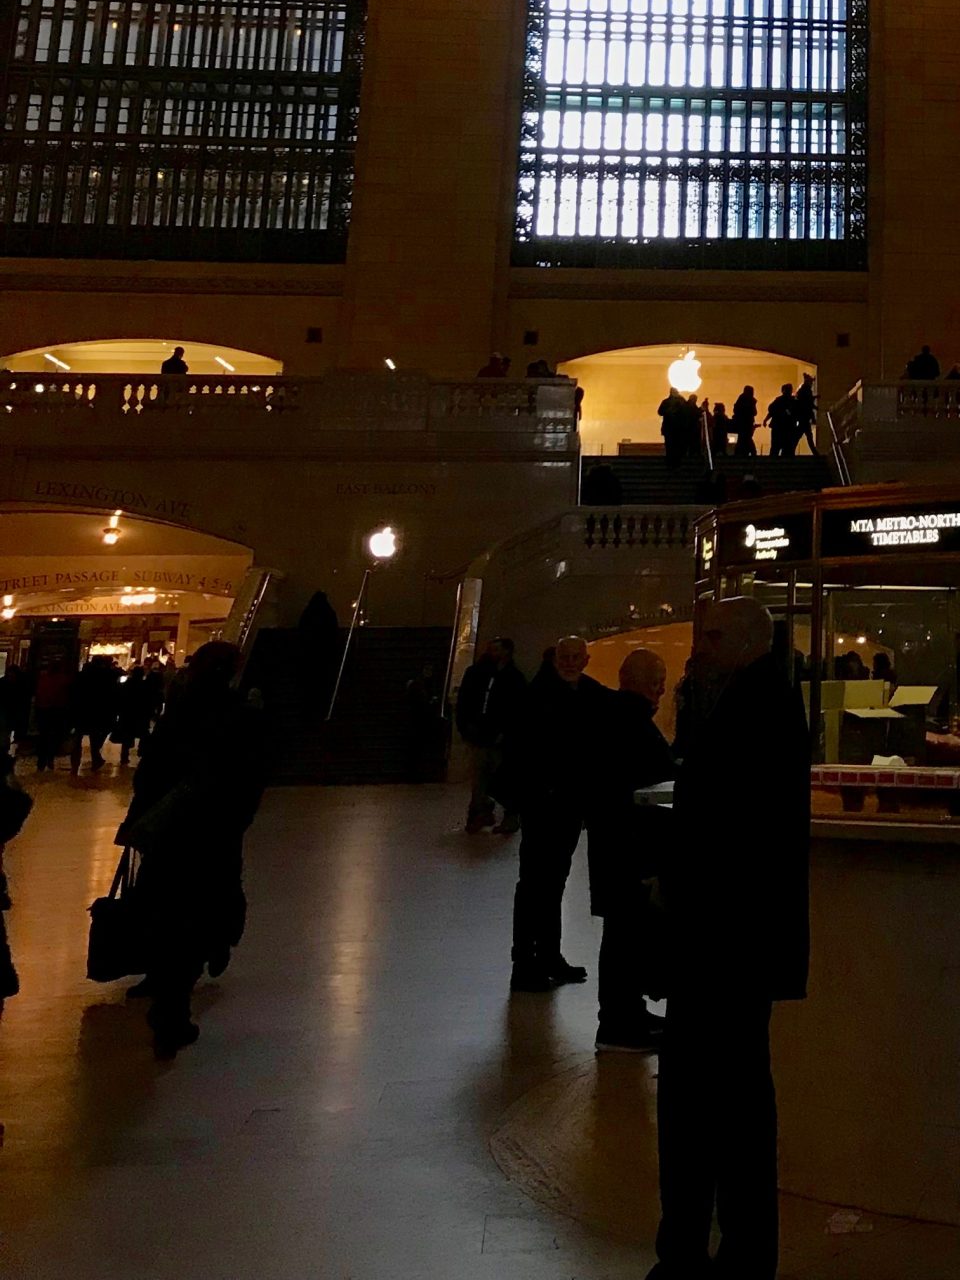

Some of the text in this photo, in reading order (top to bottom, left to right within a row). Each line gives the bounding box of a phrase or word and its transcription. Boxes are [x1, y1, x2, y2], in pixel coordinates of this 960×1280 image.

[34, 479, 150, 508] LEXINGTON
[850, 518, 874, 533] MTA
[871, 529, 940, 546] TIMETABLES
[0, 575, 48, 592] TREET
[55, 570, 119, 584] PASSAGE
[134, 570, 194, 585] SUBWAY
